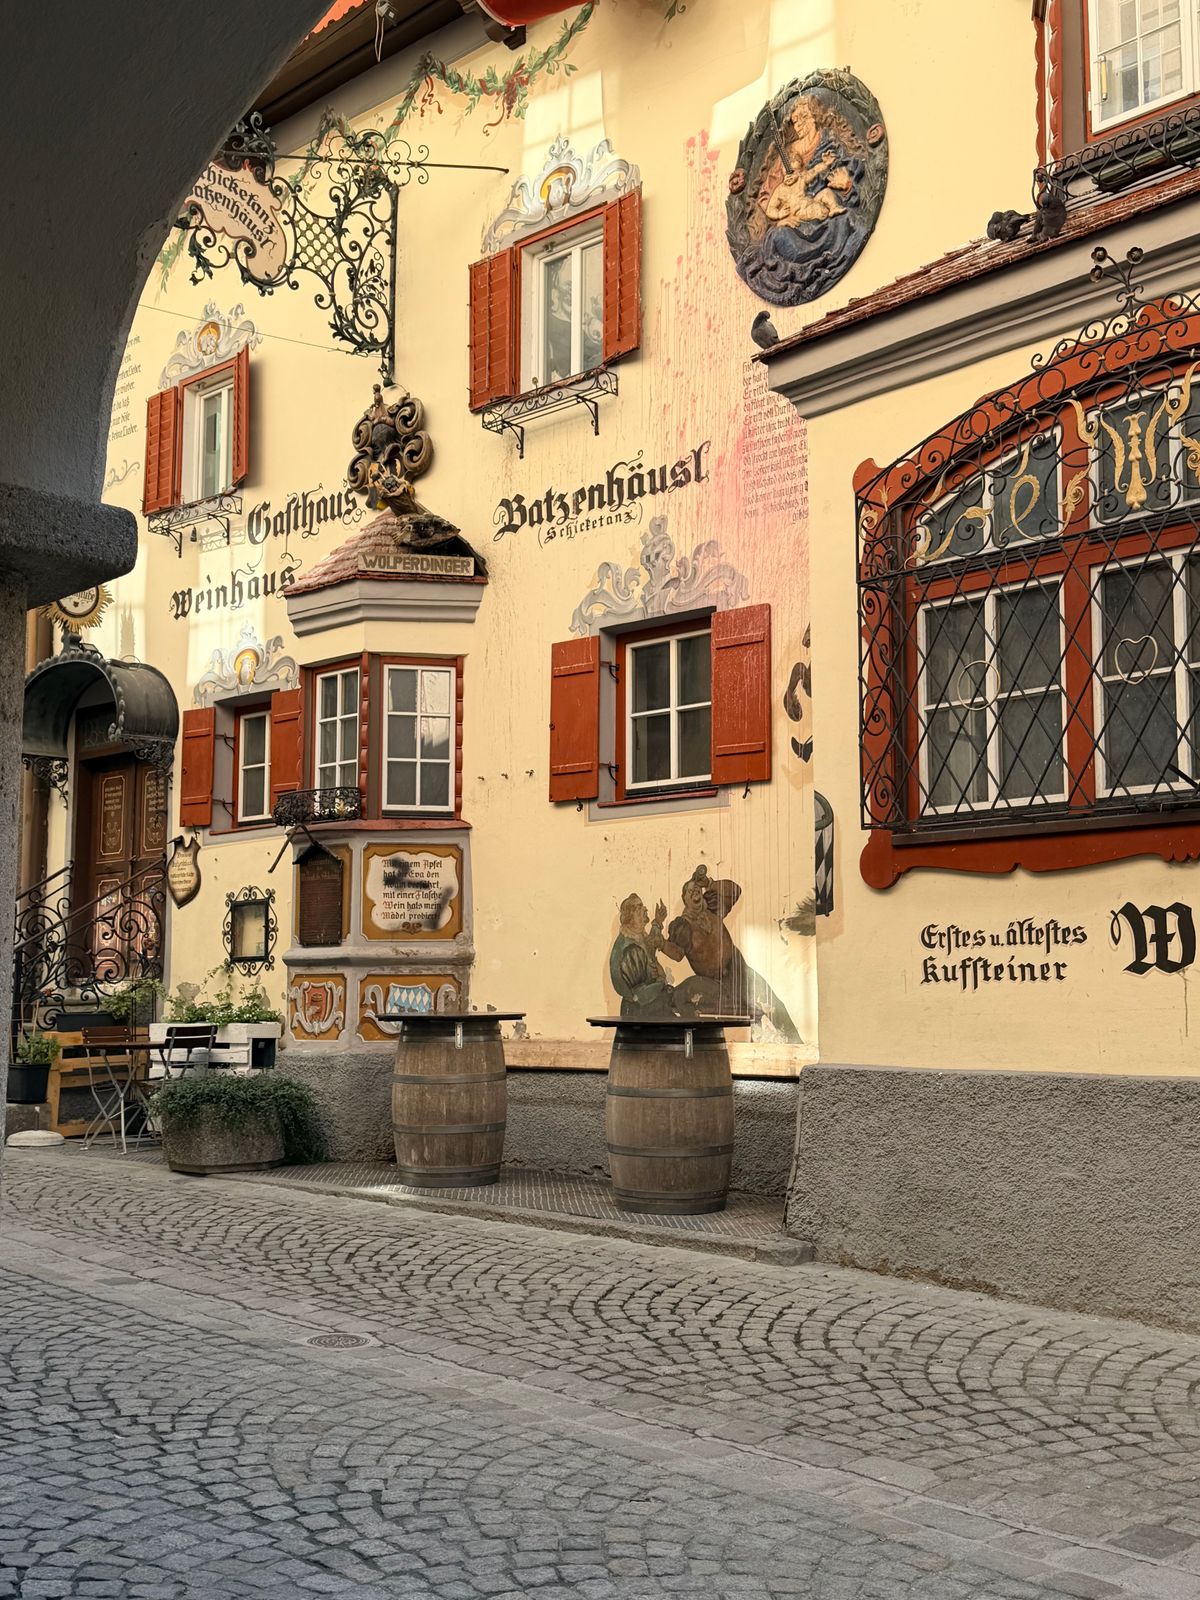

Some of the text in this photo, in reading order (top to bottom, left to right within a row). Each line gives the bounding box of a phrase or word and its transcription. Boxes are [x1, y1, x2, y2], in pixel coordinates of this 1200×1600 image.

[201, 164, 278, 235] hicketanz
[194, 183, 277, 258] atzenhäusl
[493, 441, 711, 541] Batzenhäusl
[361, 555, 471, 573] WOLPERDINGER
[169, 563, 298, 620] Weinhaus
[408, 870, 425, 879] Eva
[426, 870, 440, 878] den
[382, 902, 405, 910] Wein
[383, 890, 443, 901] mit einer Flasche
[380, 911, 406, 920] Mädel
[920, 917, 1088, 955] Erstes u. ältestes
[920, 956, 1068, 991] Kufsteiner
